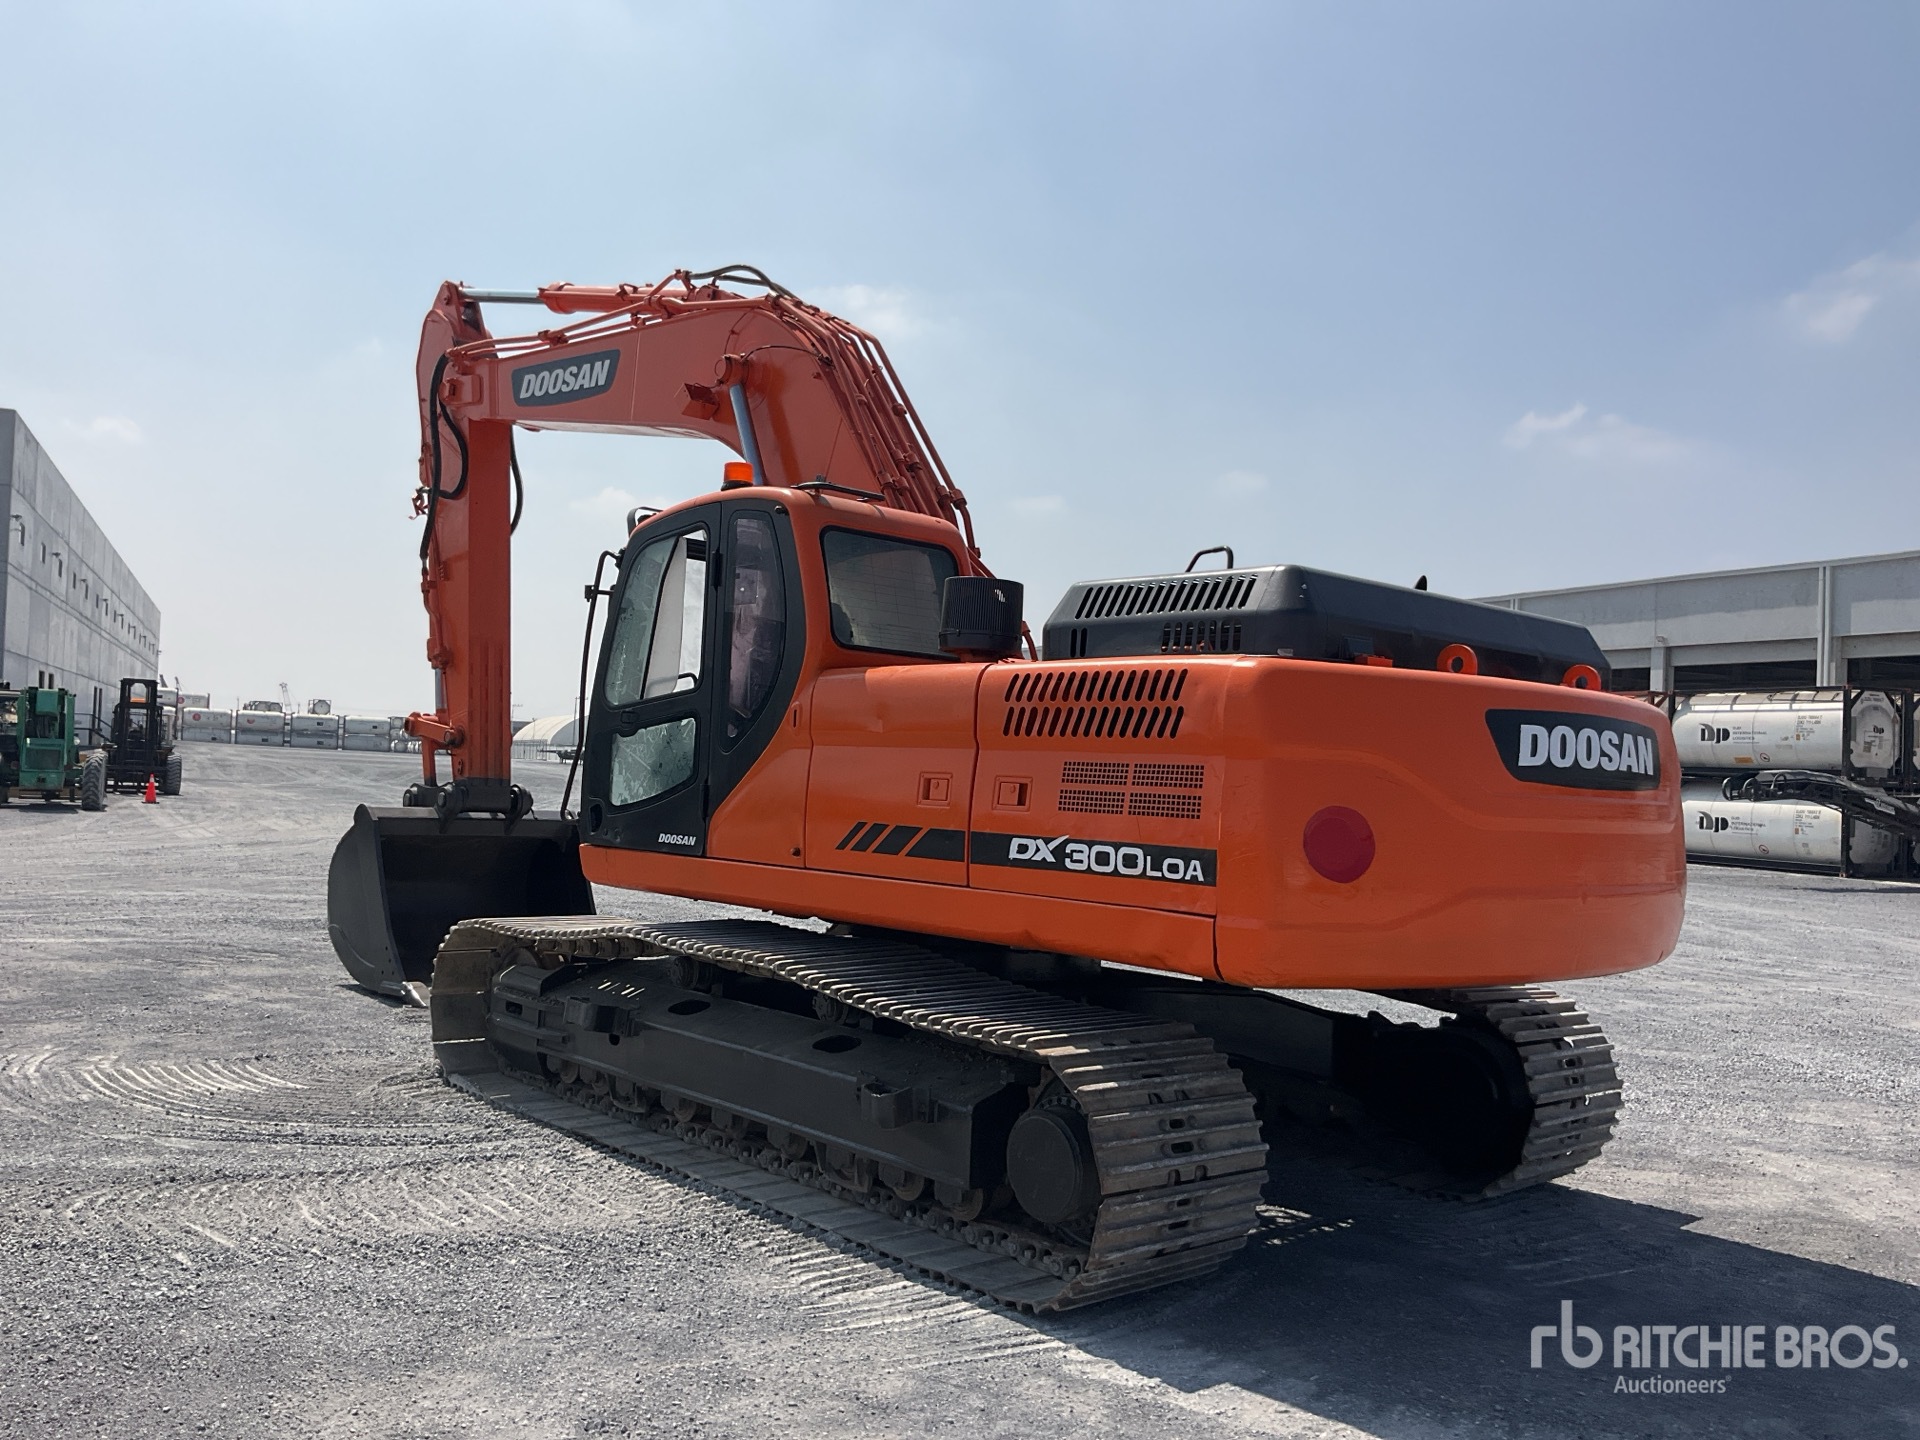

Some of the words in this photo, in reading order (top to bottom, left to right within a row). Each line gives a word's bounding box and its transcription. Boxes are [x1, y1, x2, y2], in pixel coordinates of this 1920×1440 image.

[520, 359, 611, 399] DOOSAN
[1518, 724, 1654, 776] DOOSAN
[658, 833, 697, 846] DOOSAN
